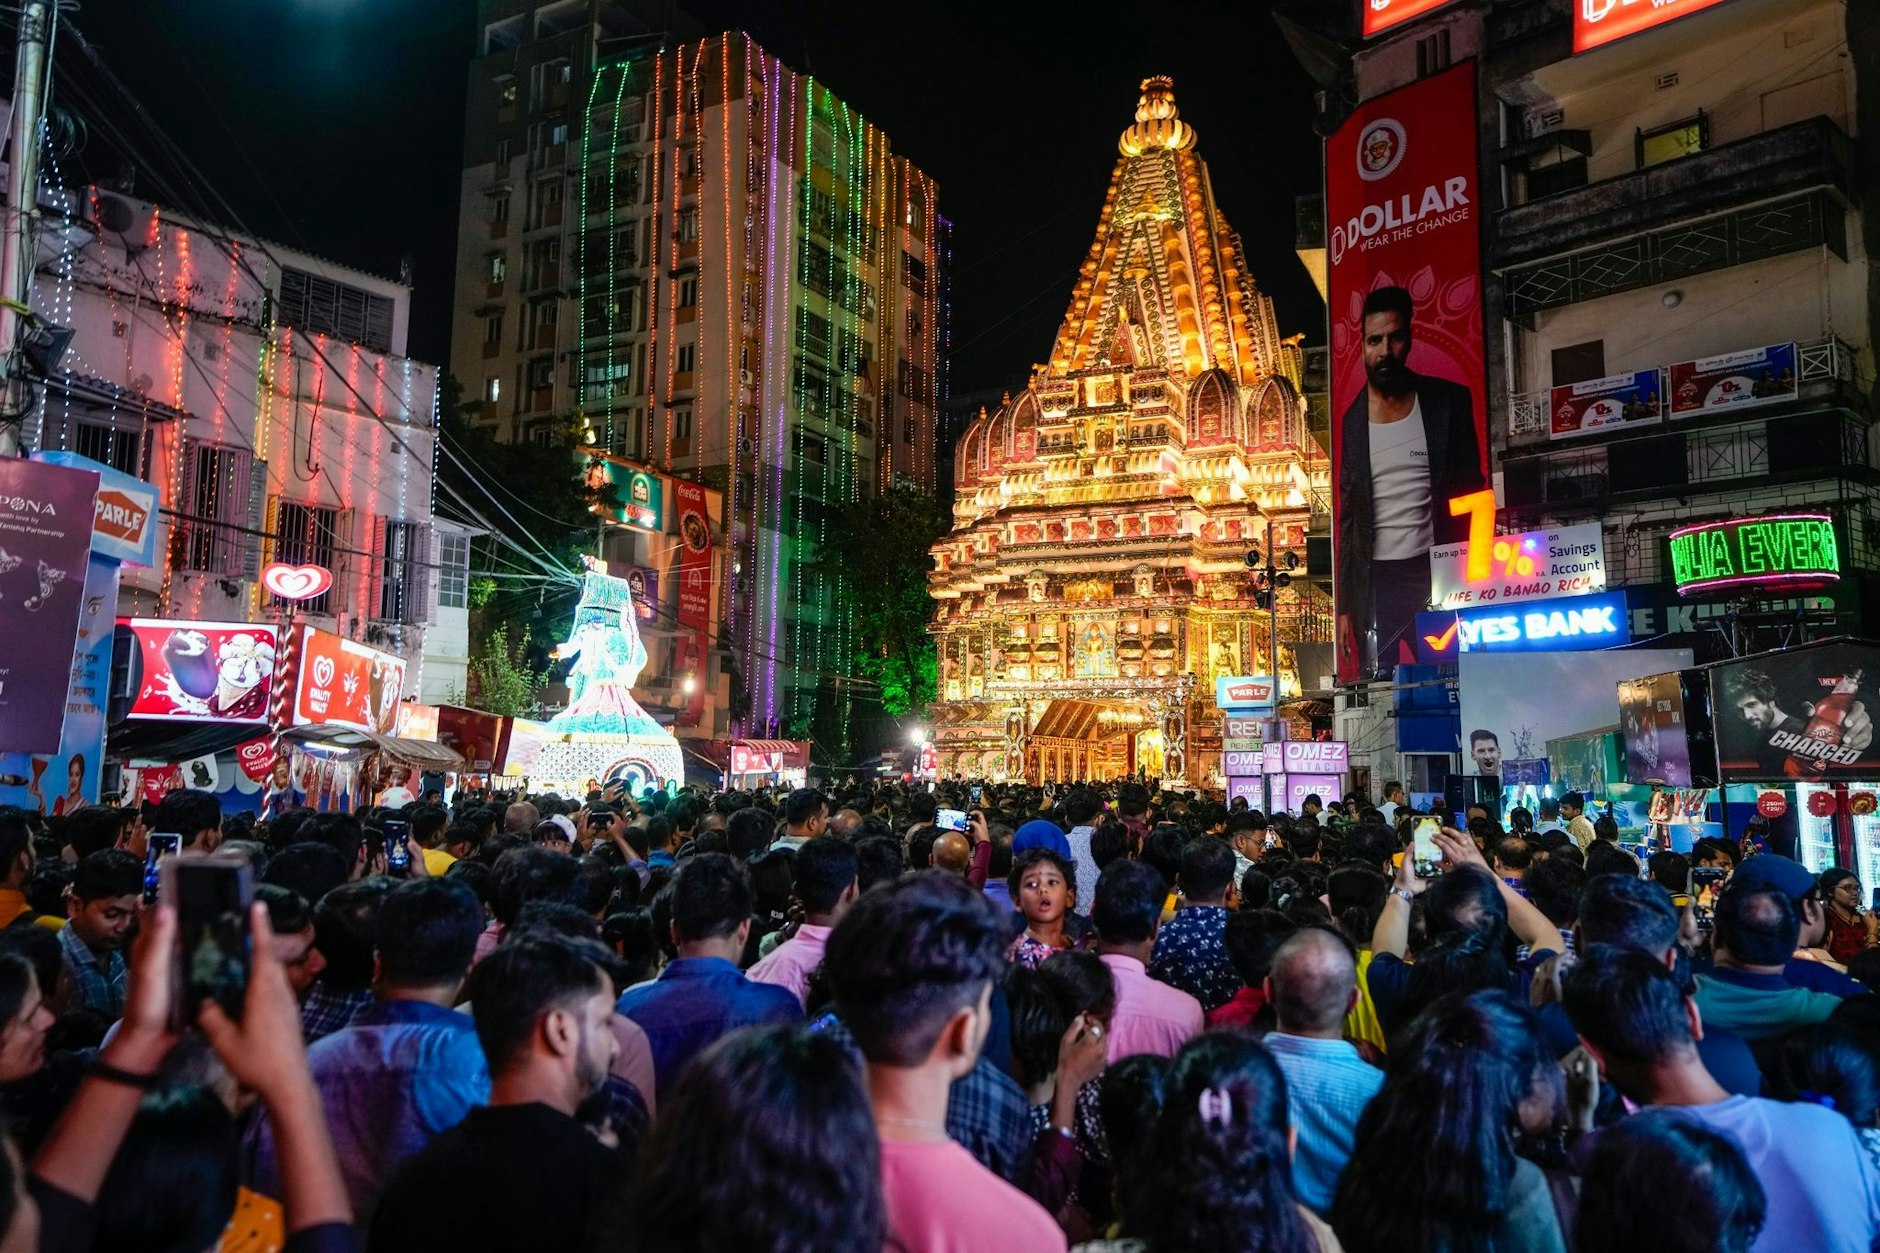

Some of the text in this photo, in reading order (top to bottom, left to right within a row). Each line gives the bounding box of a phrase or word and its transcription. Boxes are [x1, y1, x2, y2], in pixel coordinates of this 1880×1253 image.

[1347, 176, 1470, 250] DOLLAR
[1360, 208, 1469, 252] WEAR THE CHANGE
[96, 501, 142, 531] PARLE
[1433, 548, 1468, 559] Earn up to
[1550, 543, 1596, 558] Savings
[1551, 560, 1600, 576] Account
[1447, 576, 1591, 604] LIFE KO BANAO RICH
[1462, 606, 1617, 643] YES BANK
[1231, 689, 1267, 697] PARLE
[1286, 744, 1345, 760] OMEZ
[1768, 729, 1863, 766] CHARGED
[1294, 785, 1333, 796] OMEZ
